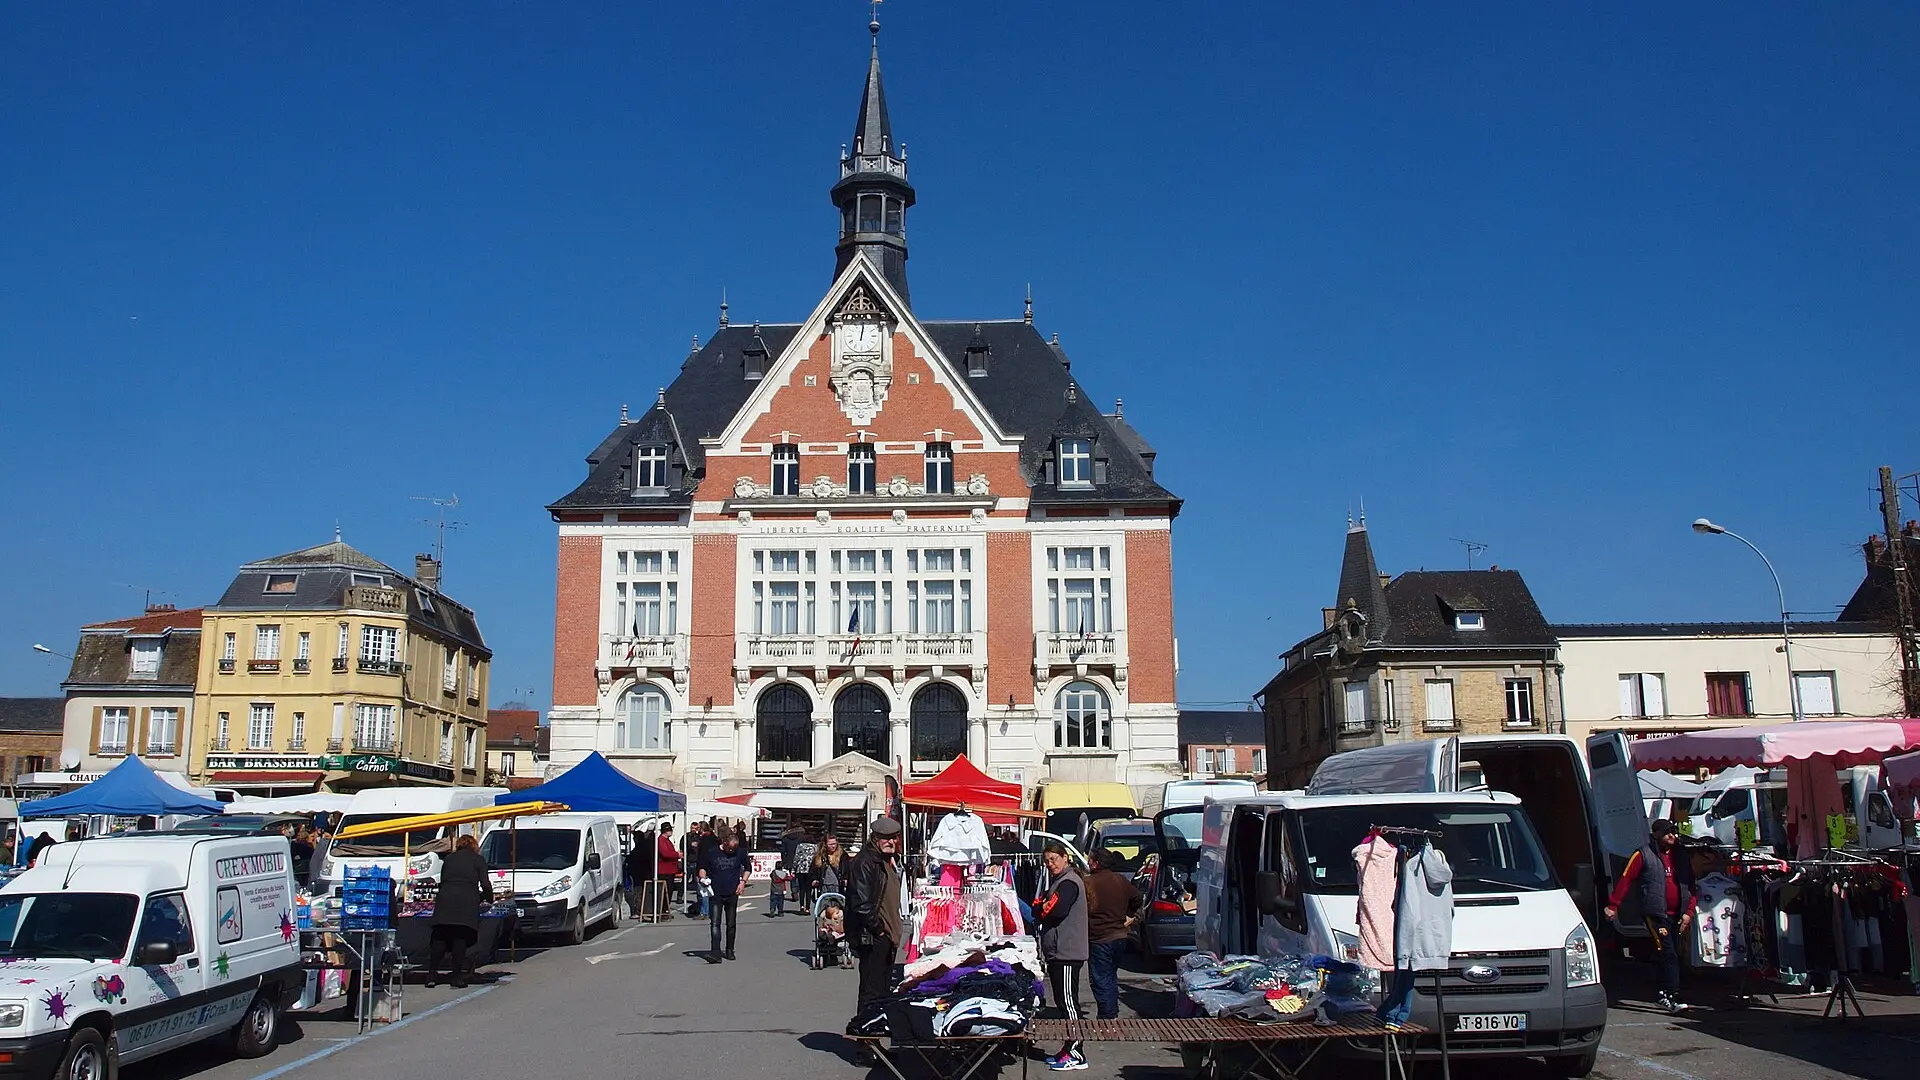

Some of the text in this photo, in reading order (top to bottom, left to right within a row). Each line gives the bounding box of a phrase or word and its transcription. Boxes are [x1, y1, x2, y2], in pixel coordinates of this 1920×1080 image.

[907, 524, 972, 532] FRATERNITE
[208, 758, 236, 768] BAR
[244, 757, 319, 768] BRASSERIE
[368, 756, 378, 764] Le
[356, 760, 388, 772] Carnot
[129, 1028, 144, 1043] 06
[144, 1023, 157, 1039] 07
[159, 1019, 169, 1032] 71
[172, 1016, 184, 1030] 91
[185, 1011, 197, 1026] 75
